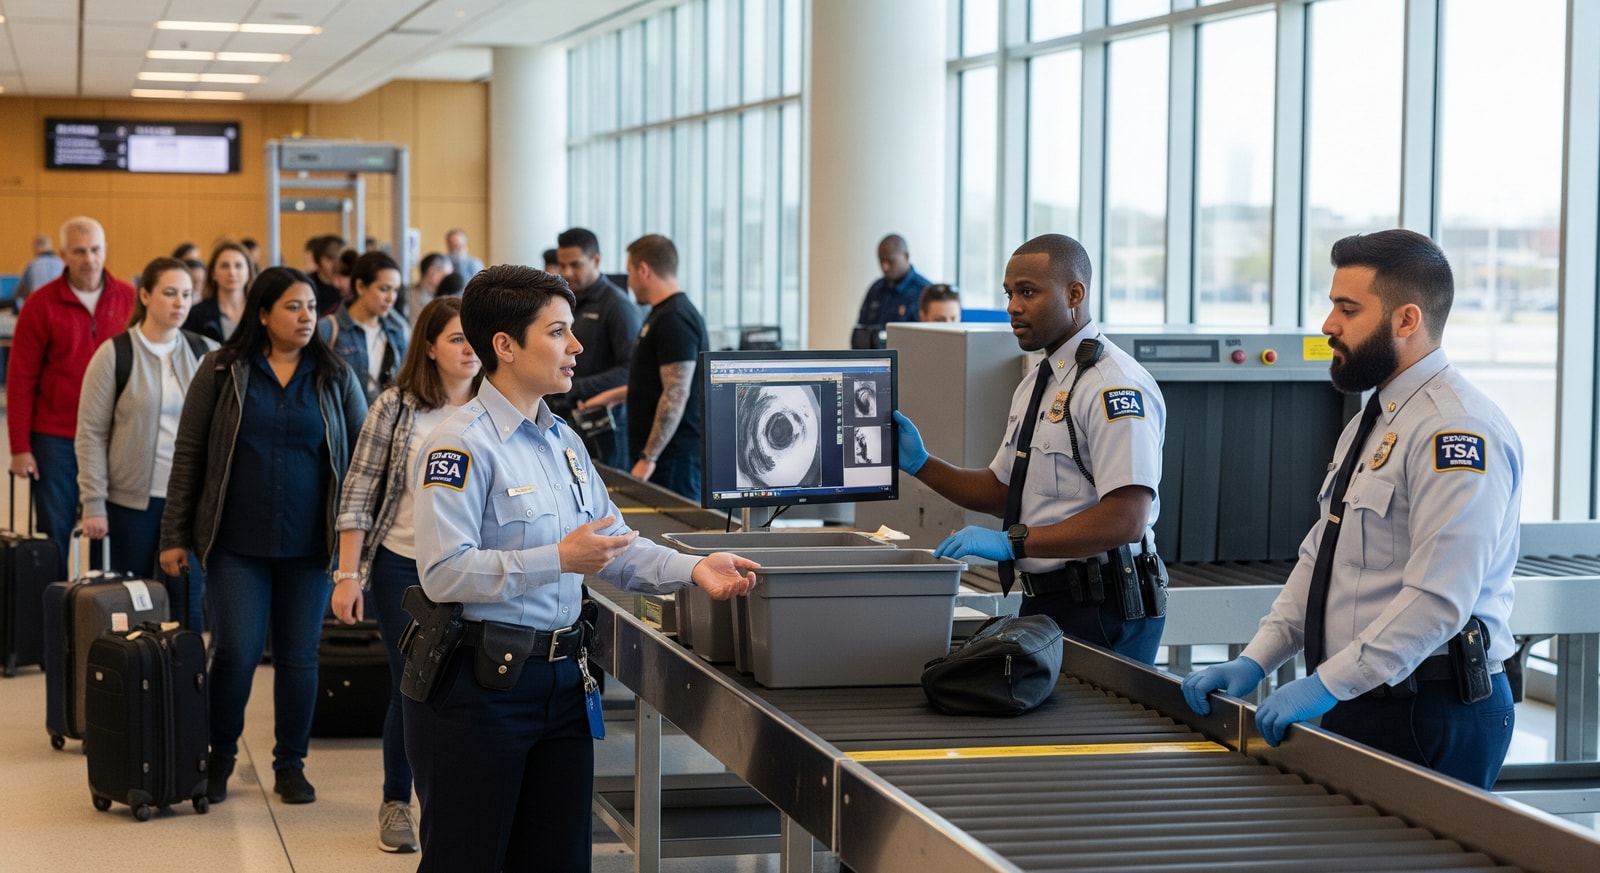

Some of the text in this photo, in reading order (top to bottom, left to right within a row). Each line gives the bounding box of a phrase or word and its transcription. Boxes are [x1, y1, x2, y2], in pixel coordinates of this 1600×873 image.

[1109, 396, 1141, 411] TSA
[1441, 443, 1480, 461] TSA
[429, 460, 461, 478] TSA
